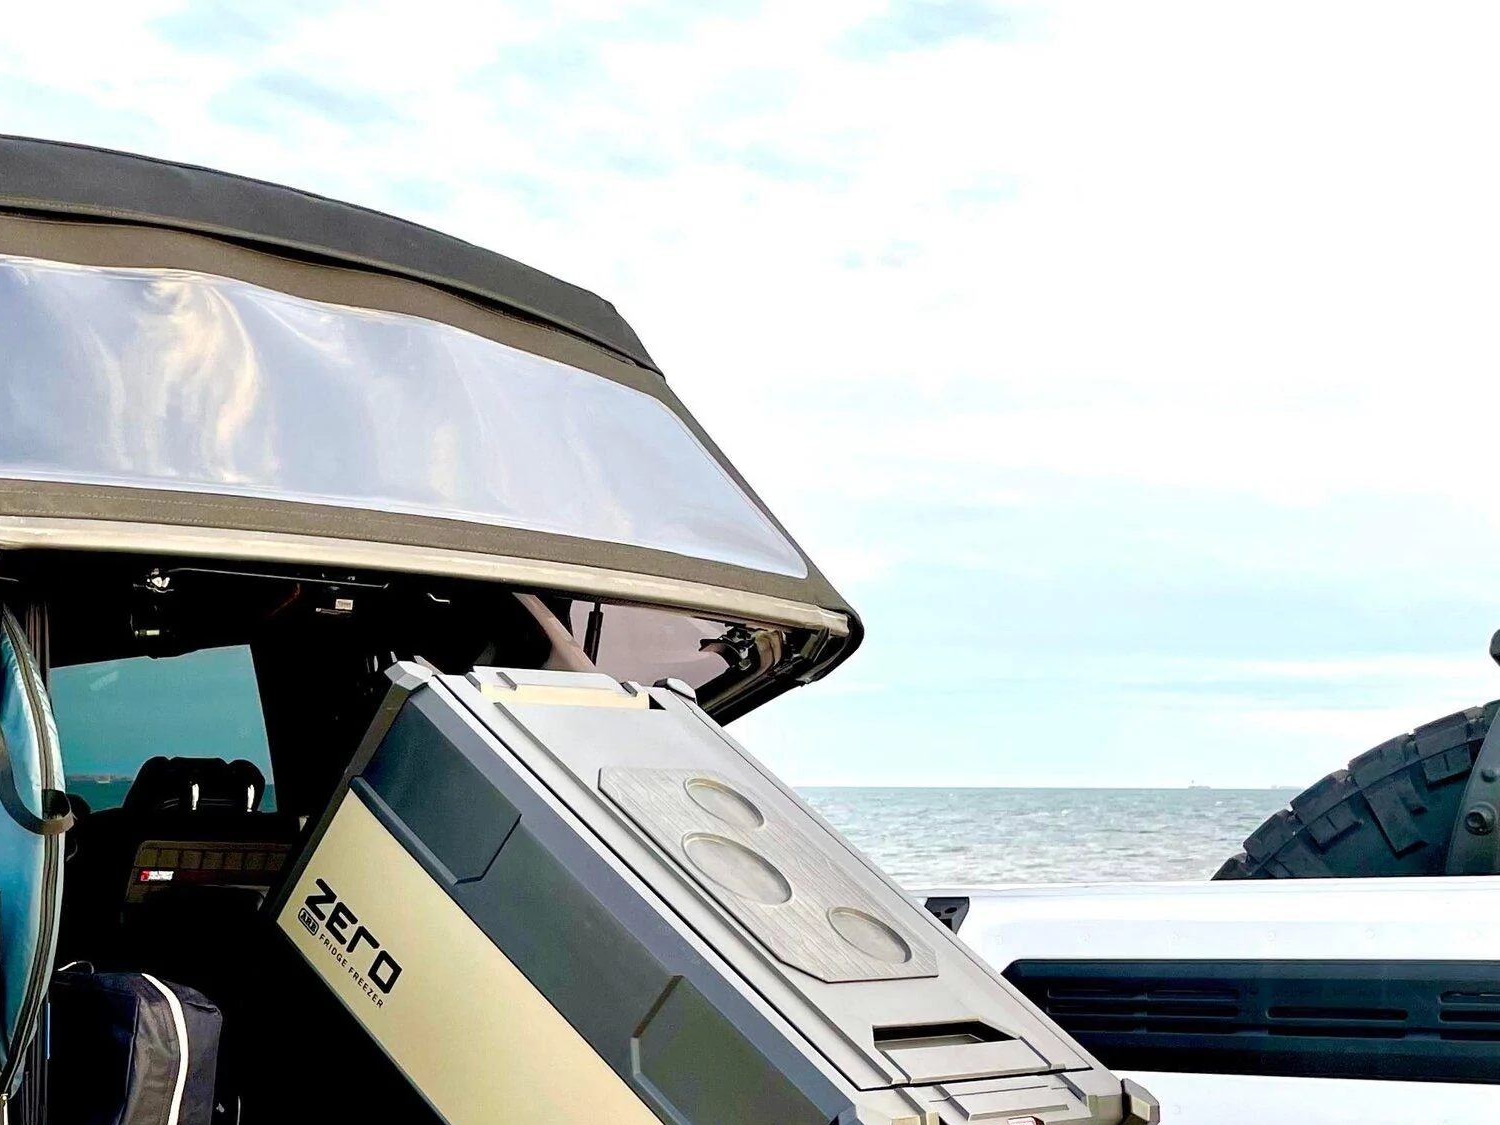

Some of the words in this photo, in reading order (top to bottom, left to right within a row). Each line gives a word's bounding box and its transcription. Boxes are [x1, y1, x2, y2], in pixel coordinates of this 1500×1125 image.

[300, 910, 318, 933] ARB
[319, 933, 348, 967] FRIDGE
[348, 966, 384, 1008] FREEZER
